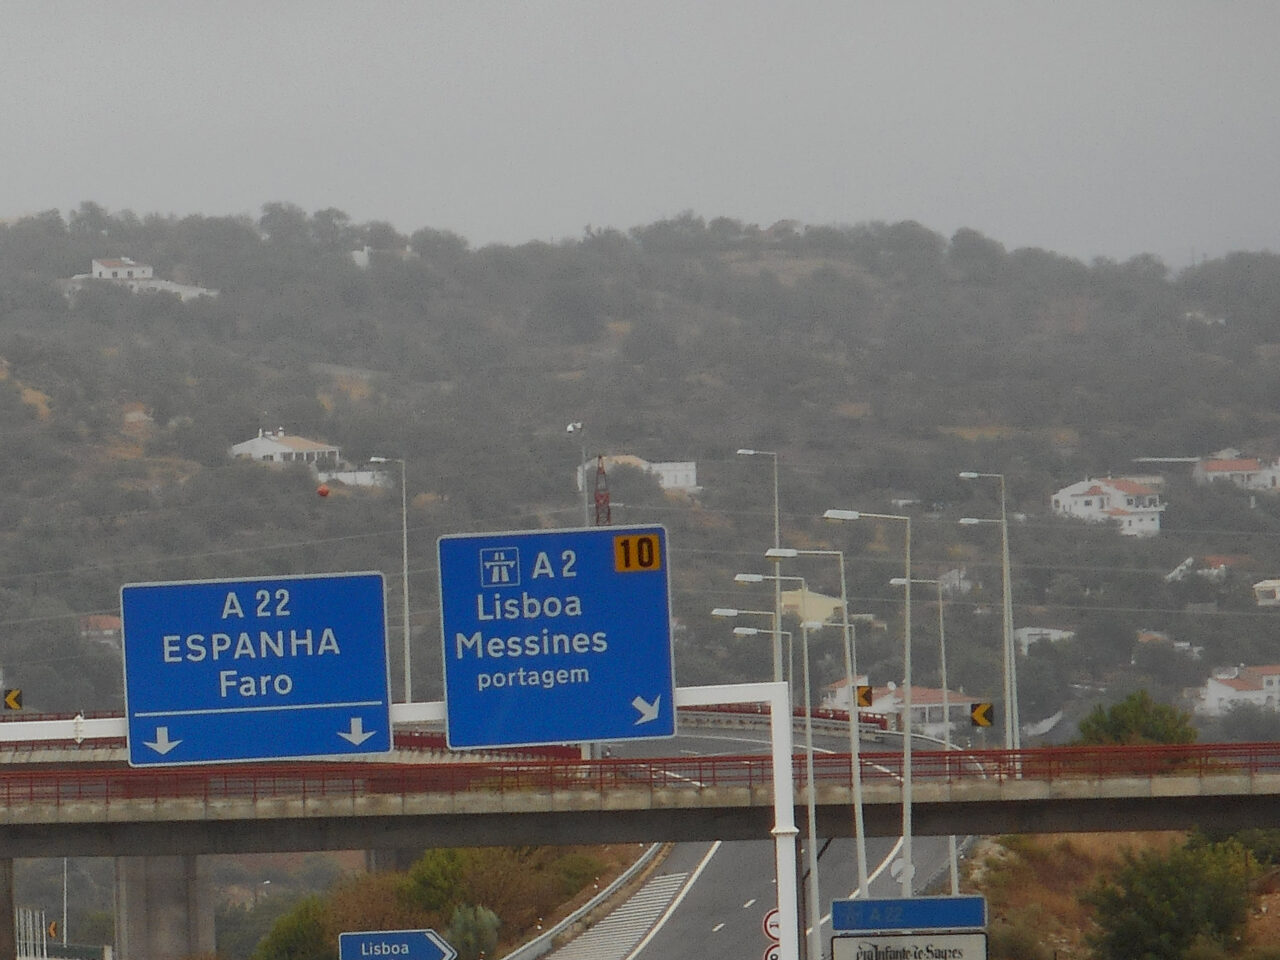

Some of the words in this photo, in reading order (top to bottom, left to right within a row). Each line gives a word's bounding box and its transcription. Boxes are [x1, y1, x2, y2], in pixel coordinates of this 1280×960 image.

[532, 552, 555, 579] A
[561, 550, 577, 577] 2
[620, 537, 654, 568] 10
[221, 591, 245, 619] A
[255, 588, 291, 617] 22
[477, 592, 583, 621] Lisboa
[163, 627, 341, 663] ESPANHA
[455, 628, 608, 660] Messines
[220, 670, 293, 697] Faro
[478, 667, 590, 691] portagem
[361, 942, 410, 956] Lisboa
